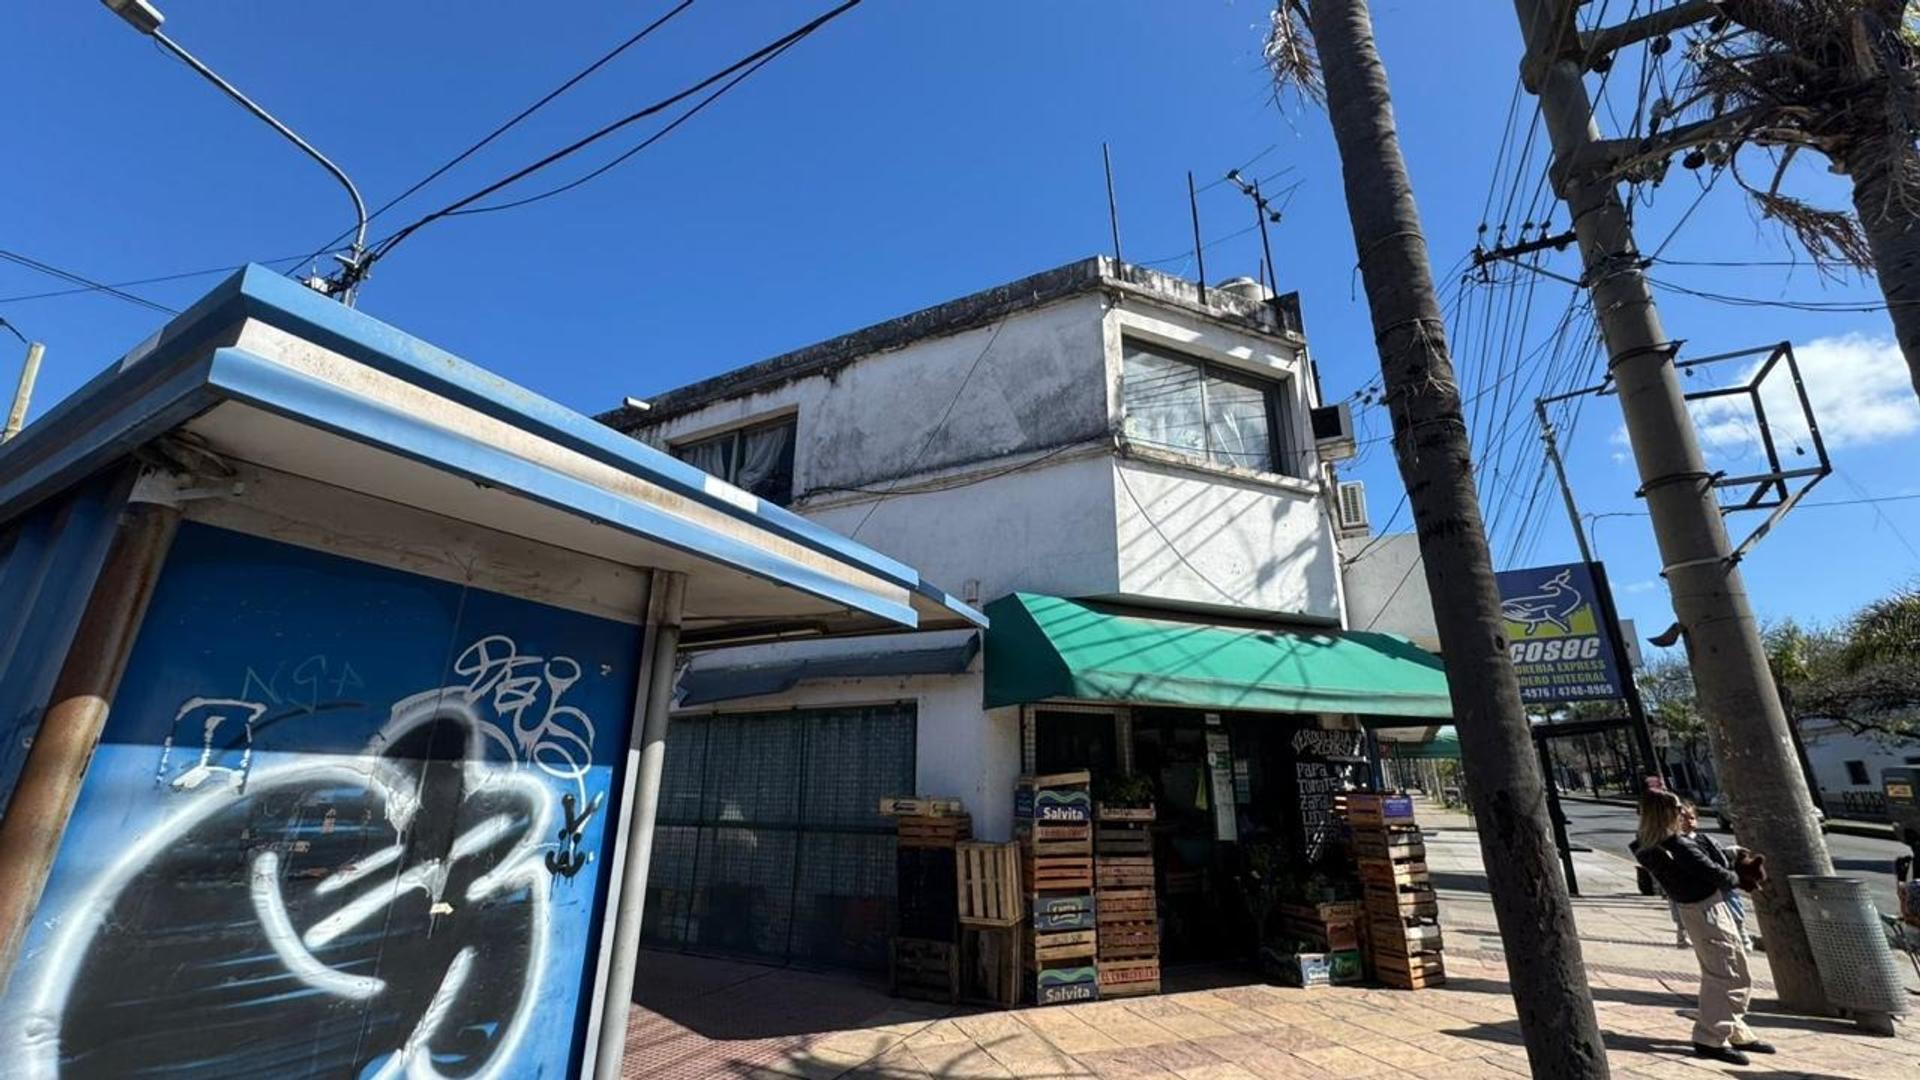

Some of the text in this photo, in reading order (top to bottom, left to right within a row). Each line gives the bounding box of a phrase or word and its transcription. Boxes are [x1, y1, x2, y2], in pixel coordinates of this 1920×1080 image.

[1557, 659, 1606, 672] EXPRESS
[1520, 671, 1608, 686] DERO INTEGRAL
[1043, 806, 1084, 820] Salvita
[1046, 985, 1091, 1001] Salvita
